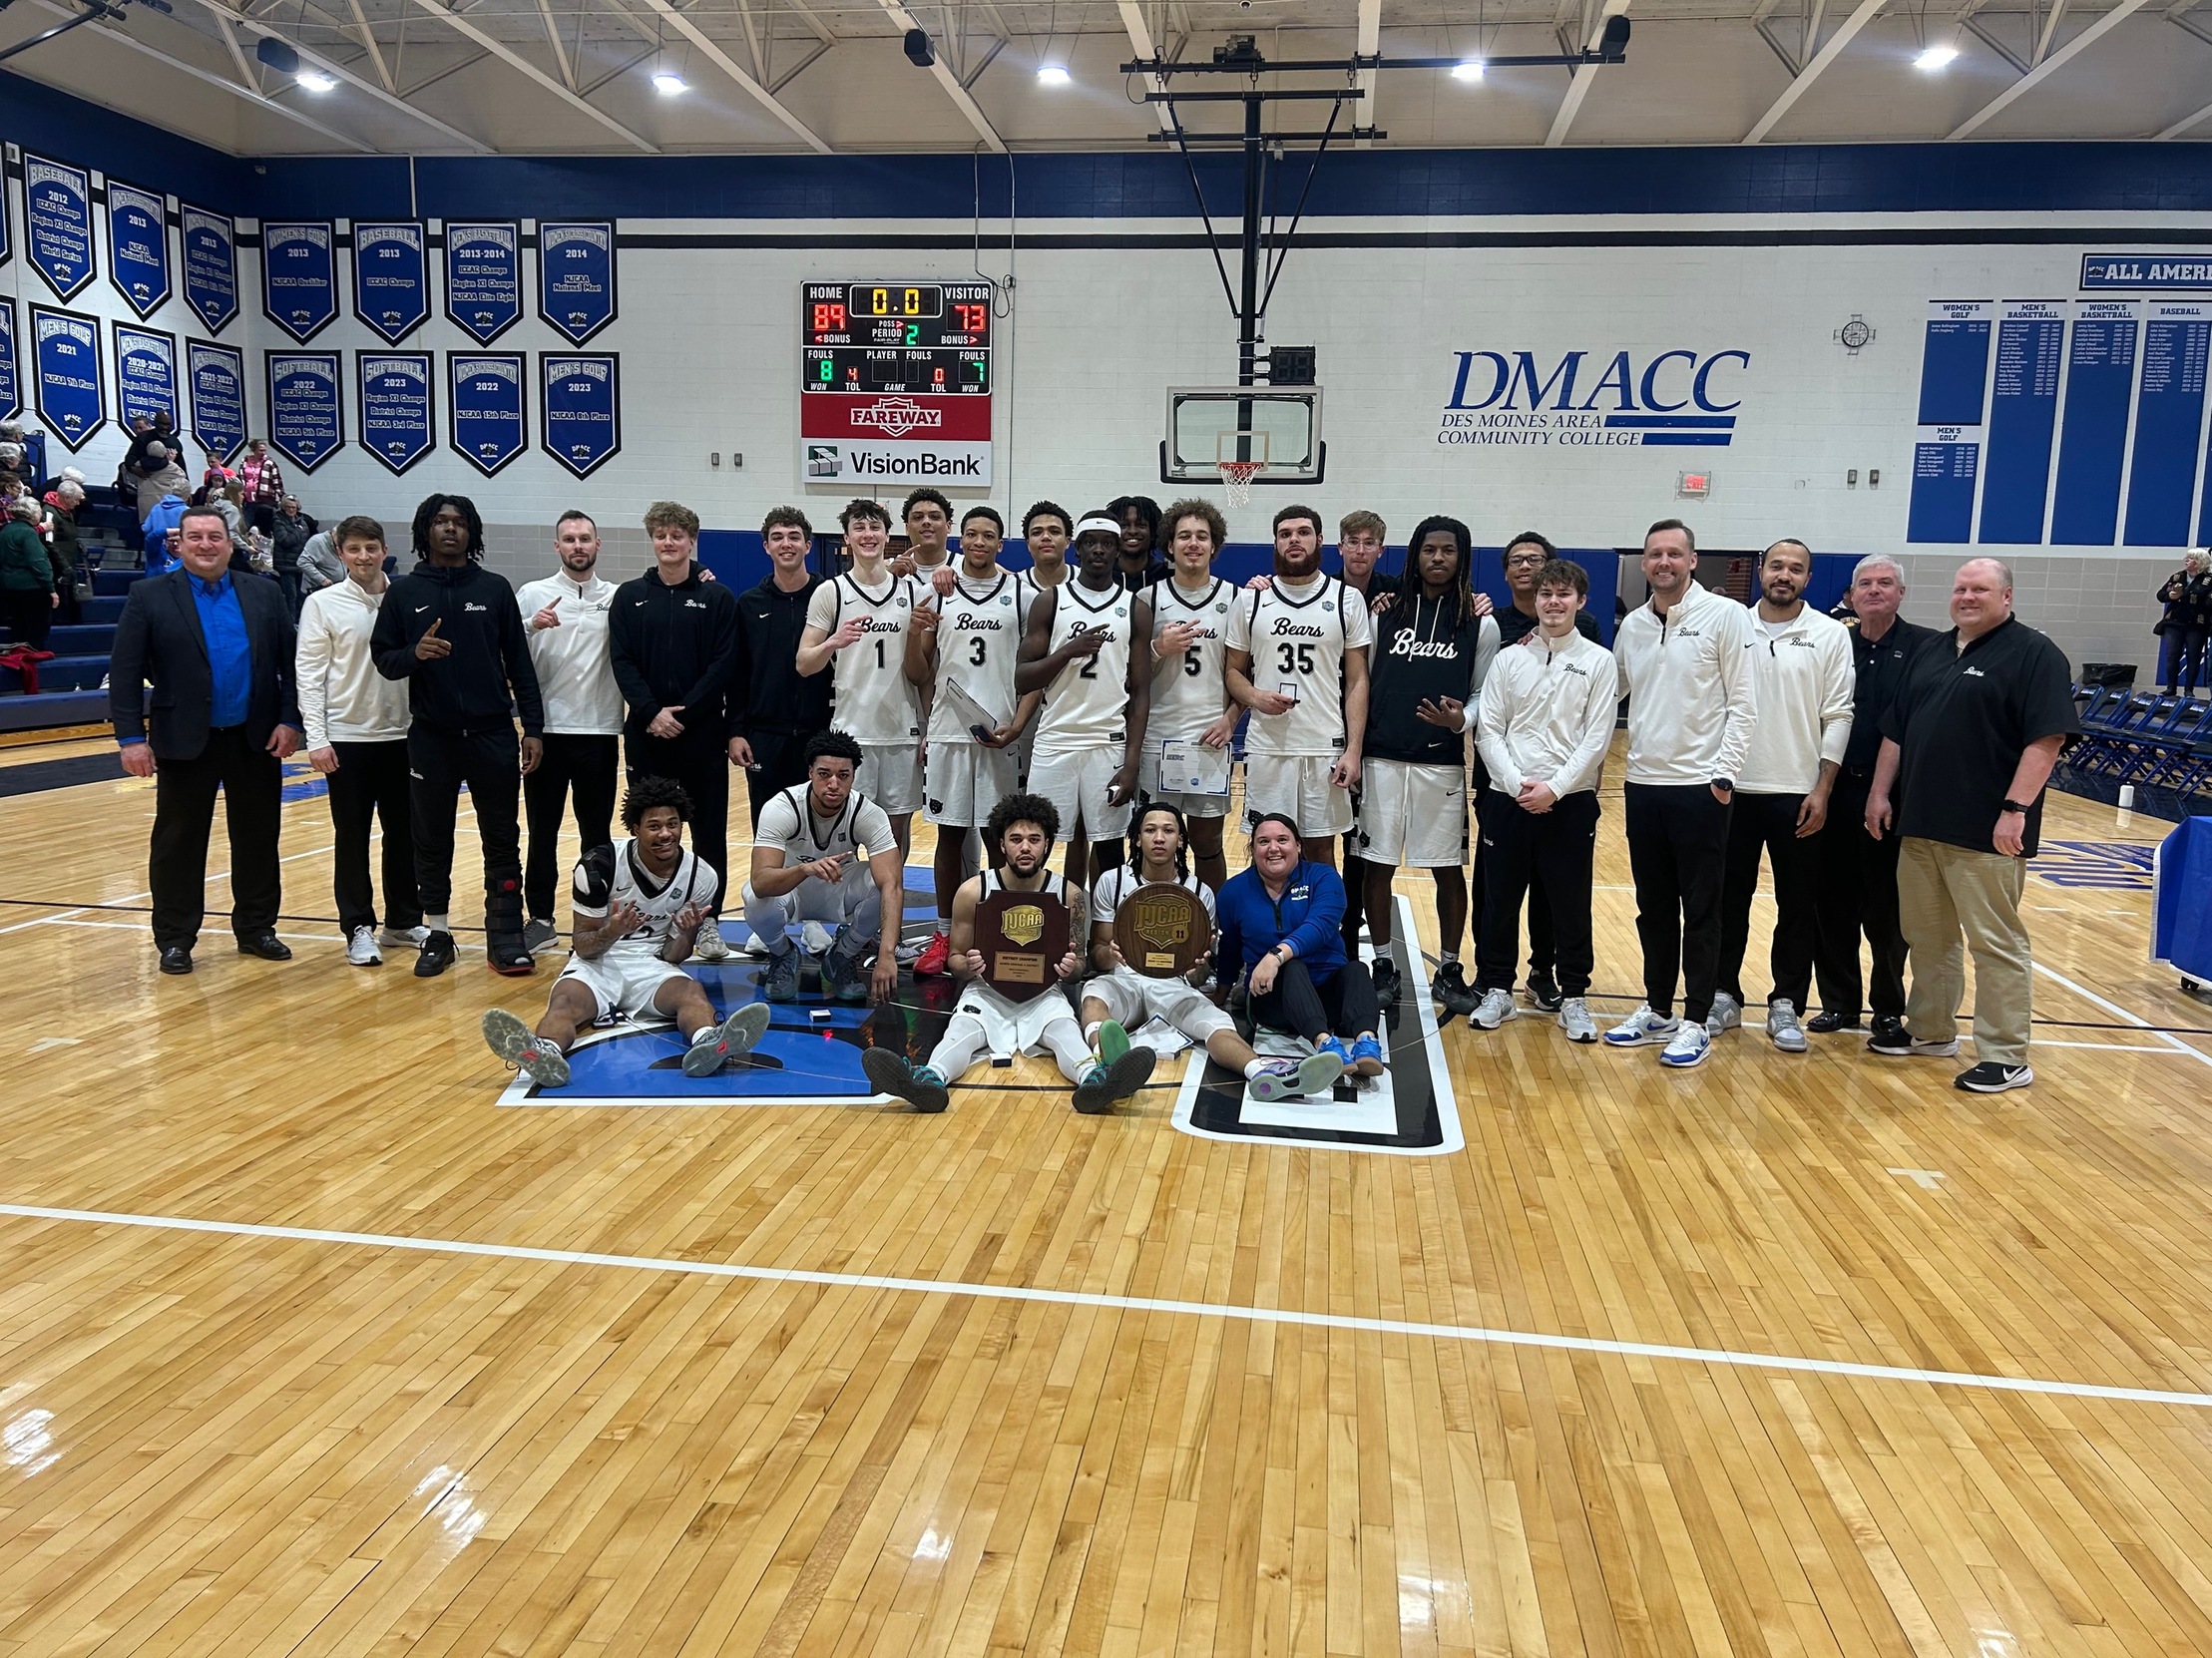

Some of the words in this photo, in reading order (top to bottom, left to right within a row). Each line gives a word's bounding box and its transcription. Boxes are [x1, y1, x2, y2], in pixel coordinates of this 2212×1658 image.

[29, 164, 85, 202] BASEBALL
[49, 191, 68, 205] 2012
[58, 205, 81, 219] Champs
[129, 214, 147, 227] 2013
[65, 221, 87, 236] Champs
[61, 235, 84, 250] Champs
[201, 236, 217, 248] 2013
[359, 227, 419, 251] BASEBALL
[452, 229, 472, 251] MEN'S
[473, 227, 513, 251] BASKETBALL
[41, 244, 60, 257] World
[62, 249, 82, 262] Series
[481, 266, 507, 275] Champs
[2104, 264, 2142, 279] ALL
[389, 277, 415, 287] Champs
[453, 279, 475, 288] Region
[497, 293, 515, 302] Eight
[810, 287, 842, 298] HOME
[945, 287, 989, 299] VISITOR
[814, 304, 844, 330] 89
[955, 304, 984, 330] 73
[39, 319, 68, 341] MEN'S
[69, 322, 92, 347] GOLF
[872, 328, 902, 337] PERIOD
[906, 324, 918, 345] 2
[941, 335, 968, 344] BONUS
[57, 343, 77, 355] 2021
[906, 351, 932, 360] FOULS
[959, 351, 985, 360] FOULS
[128, 357, 165, 371] 2020-2021
[274, 360, 333, 383] SOFTBALL
[365, 360, 425, 383] SOFTBALL
[820, 360, 832, 380] 8
[201, 372, 233, 385] 2021-2022
[549, 362, 581, 384] MEN'S
[583, 362, 608, 382] GOLF
[848, 367, 857, 381] 4
[935, 368, 944, 382] 0
[973, 362, 984, 382] 7
[79, 379, 95, 390] Place
[1445, 350, 1751, 412] DMACC
[302, 389, 327, 398] Champs
[366, 394, 388, 403] Region
[400, 394, 425, 403] Champs
[457, 410, 482, 419] NJCAA
[852, 410, 938, 425] FAREWAY
[1441, 414, 1473, 427] DES
[1478, 414, 1548, 427] MOINES
[1552, 414, 1601, 428] AREA
[1438, 431, 1553, 445] COMMUNITY
[1559, 432, 1640, 446] COLLEGE
[851, 452, 980, 476] VisionBank
[464, 603, 487, 612] Bears
[861, 618, 901, 632] Bears
[955, 614, 1002, 631] Bears
[1270, 618, 1324, 637] Bears
[1068, 622, 1116, 642] Brs
[1678, 627, 1699, 636] Bears
[1390, 627, 1458, 659] Bears
[1790, 637, 1815, 647] Bears
[875, 639, 885, 668] 1
[970, 636, 987, 666] 3
[1278, 642, 1316, 674] 35
[1185, 646, 1201, 676] 5
[1563, 663, 1587, 675] Bears
[1004, 913, 1042, 931] NJCAA
[1137, 905, 1188, 928] NJCAA
